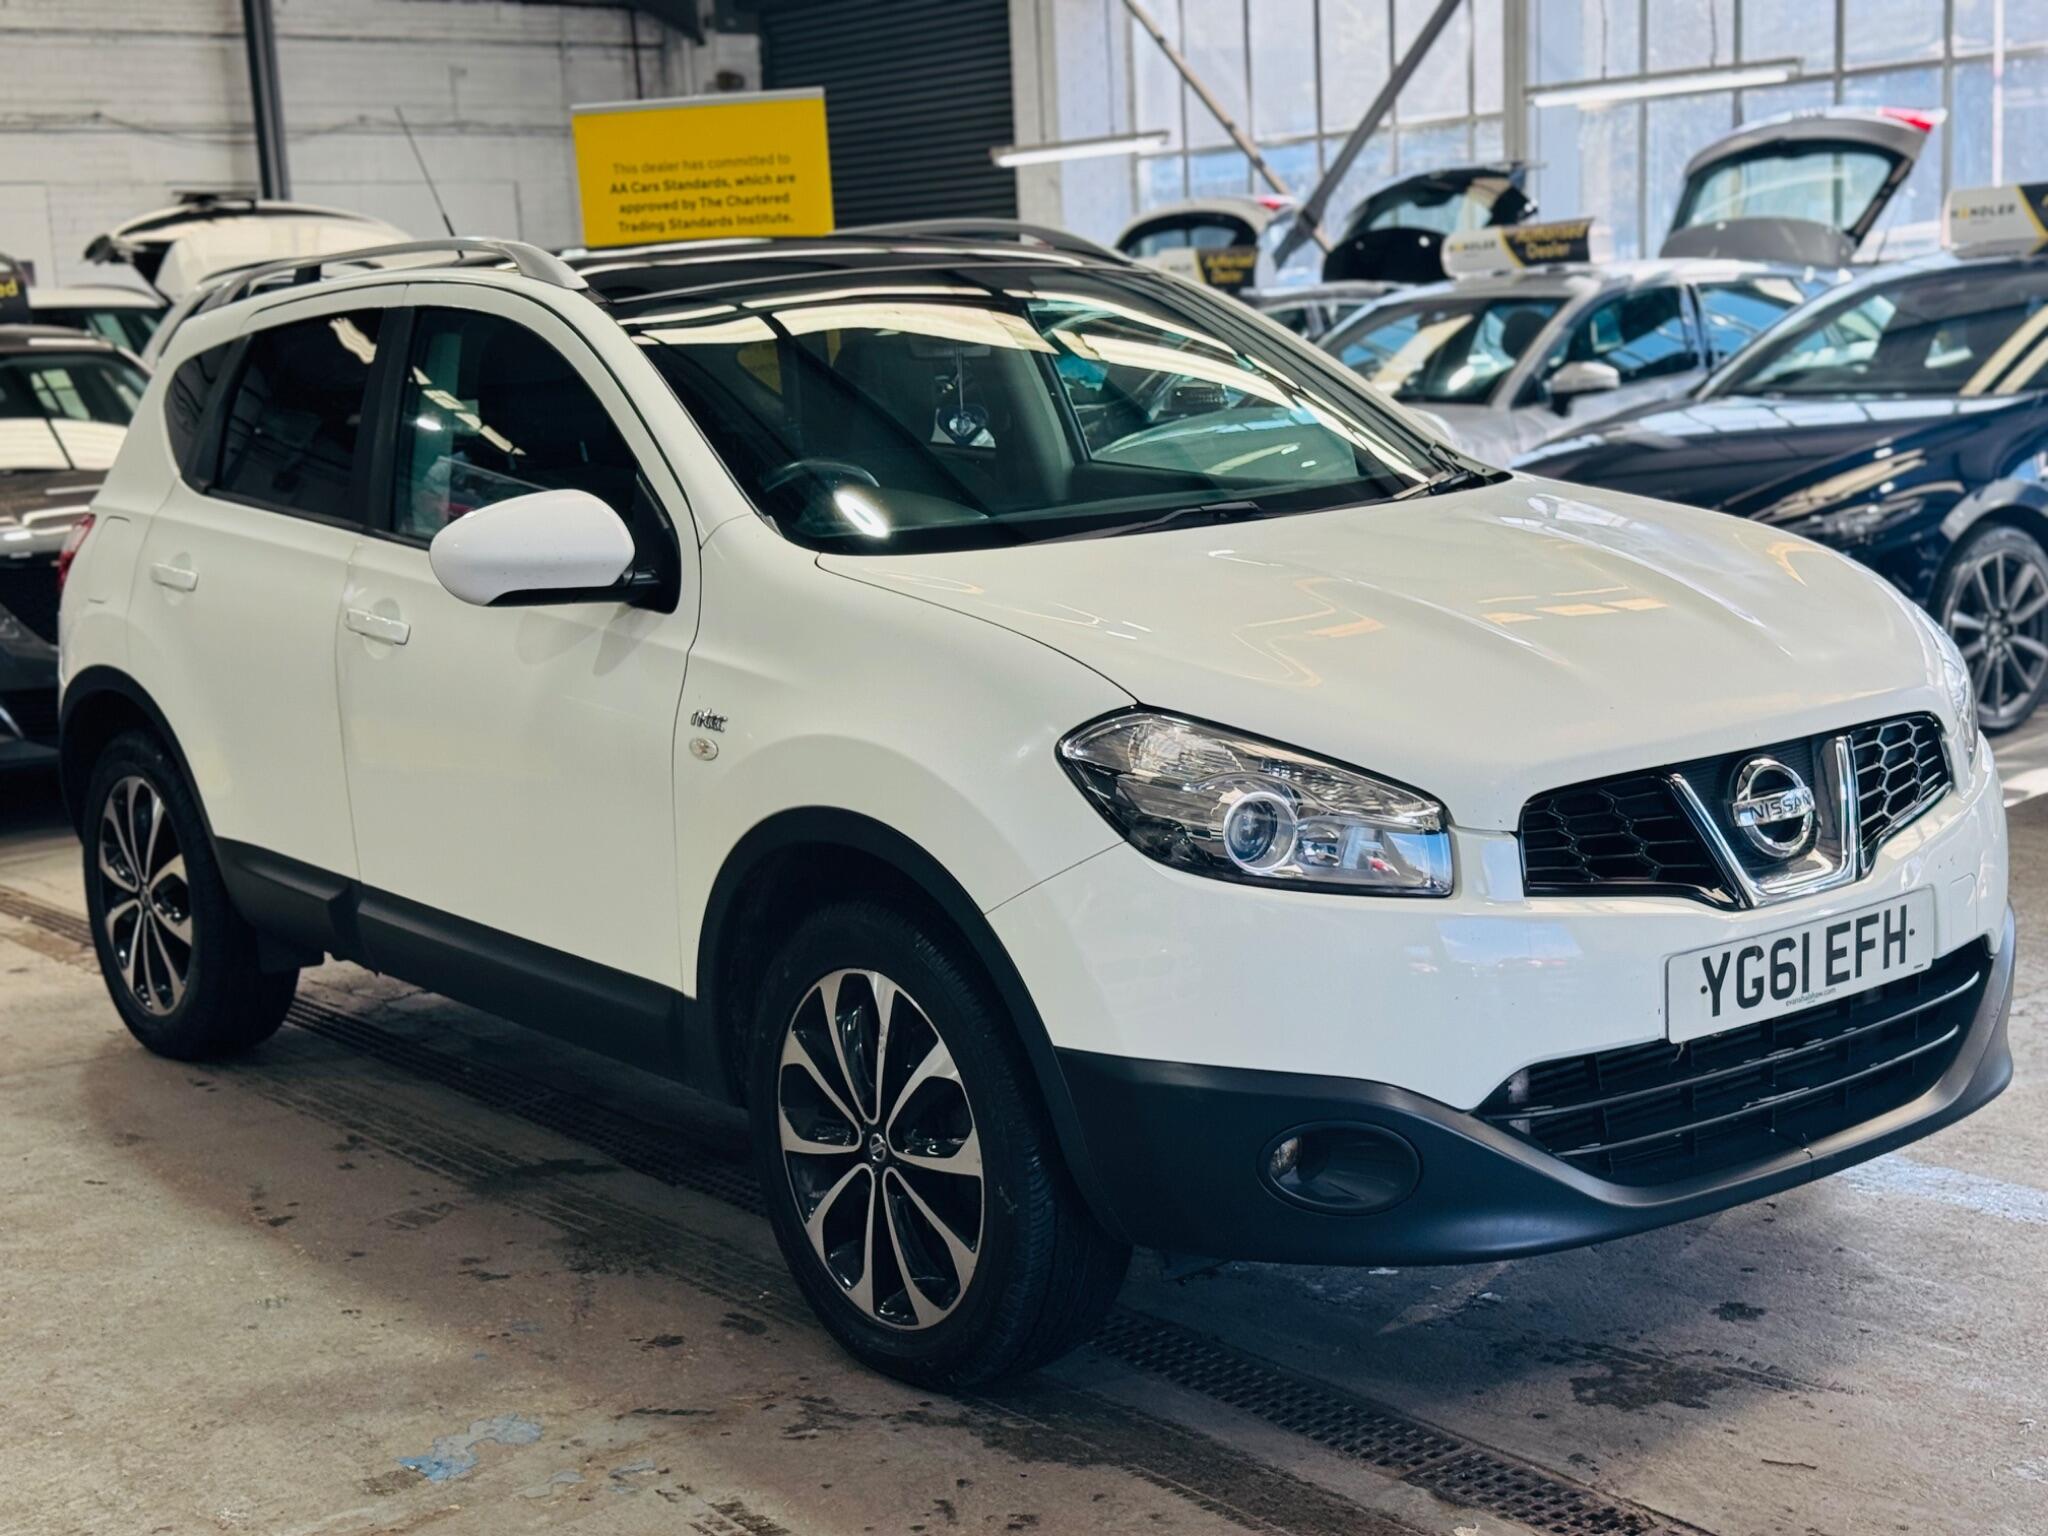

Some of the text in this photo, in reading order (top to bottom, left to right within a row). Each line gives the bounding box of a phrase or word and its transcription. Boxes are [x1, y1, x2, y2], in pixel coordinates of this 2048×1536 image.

[610, 183, 628, 194] AA
[631, 180, 660, 192] Cars
[776, 174, 796, 183] are
[682, 199, 697, 212] by
[699, 195, 722, 208] The
[726, 192, 790, 207] Chartered
[619, 219, 666, 233] Trading
[668, 215, 733, 231] Standards
[1750, 791, 1812, 818] NISSAN
[1702, 904, 1907, 1017] YG61 EFH
